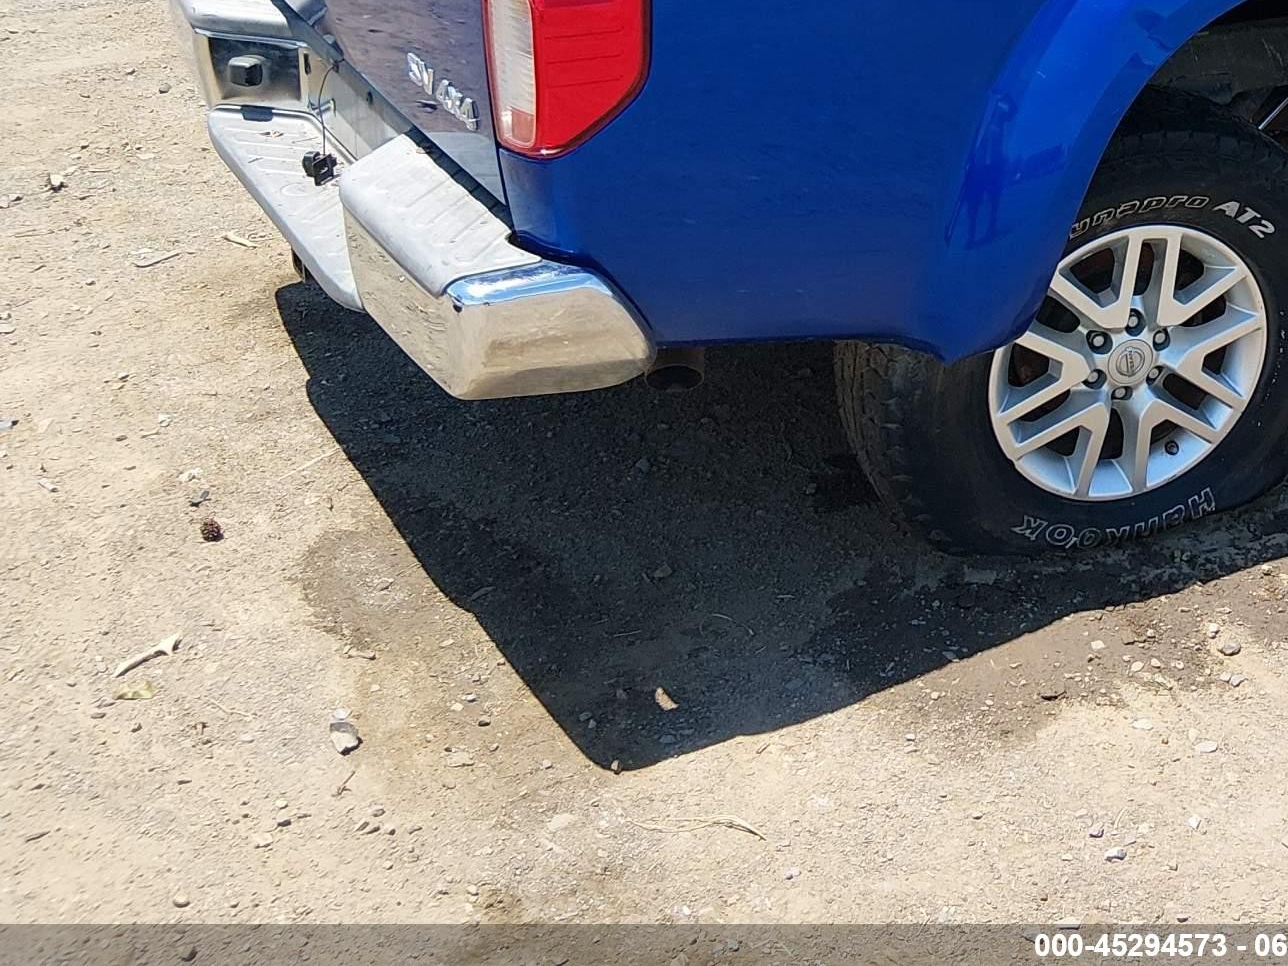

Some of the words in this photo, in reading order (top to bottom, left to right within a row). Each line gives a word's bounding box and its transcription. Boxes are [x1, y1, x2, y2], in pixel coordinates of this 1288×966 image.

[406, 52, 434, 95] SV
[1070, 195, 1210, 240] ynapro
[1212, 201, 1276, 239] AT2
